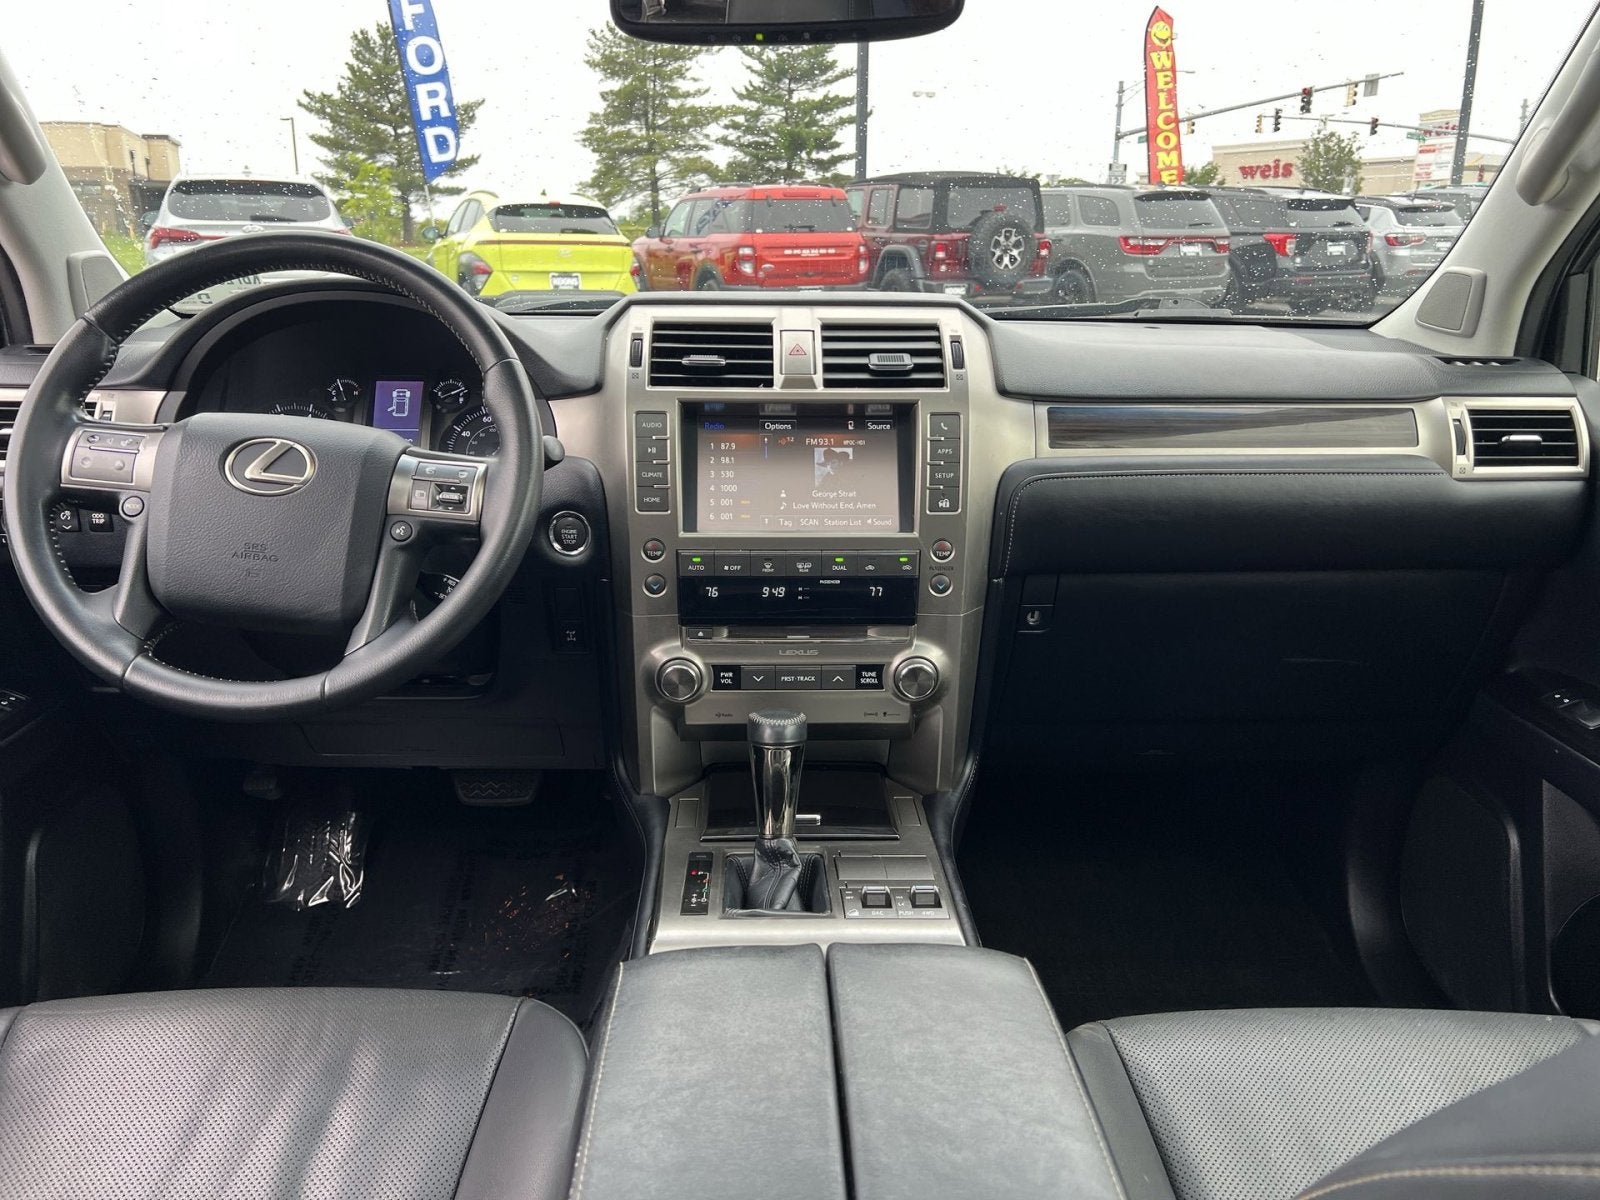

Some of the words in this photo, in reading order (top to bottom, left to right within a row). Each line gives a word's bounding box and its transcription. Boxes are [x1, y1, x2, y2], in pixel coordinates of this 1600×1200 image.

[400, 0, 457, 163] FORD
[1150, 50, 1179, 185] WELCOME
[1238, 159, 1293, 180] weis
[764, 422, 792, 431] Options
[867, 422, 891, 430] Source
[812, 490, 837, 499] George
[838, 490, 857, 498] Strait
[840, 502, 855, 510] End,
[780, 519, 792, 527] Tag
[244, 542, 267, 551] SRS
[231, 552, 279, 562] AIRBAG
[705, 587, 719, 598] 76
[869, 587, 883, 597] 77
